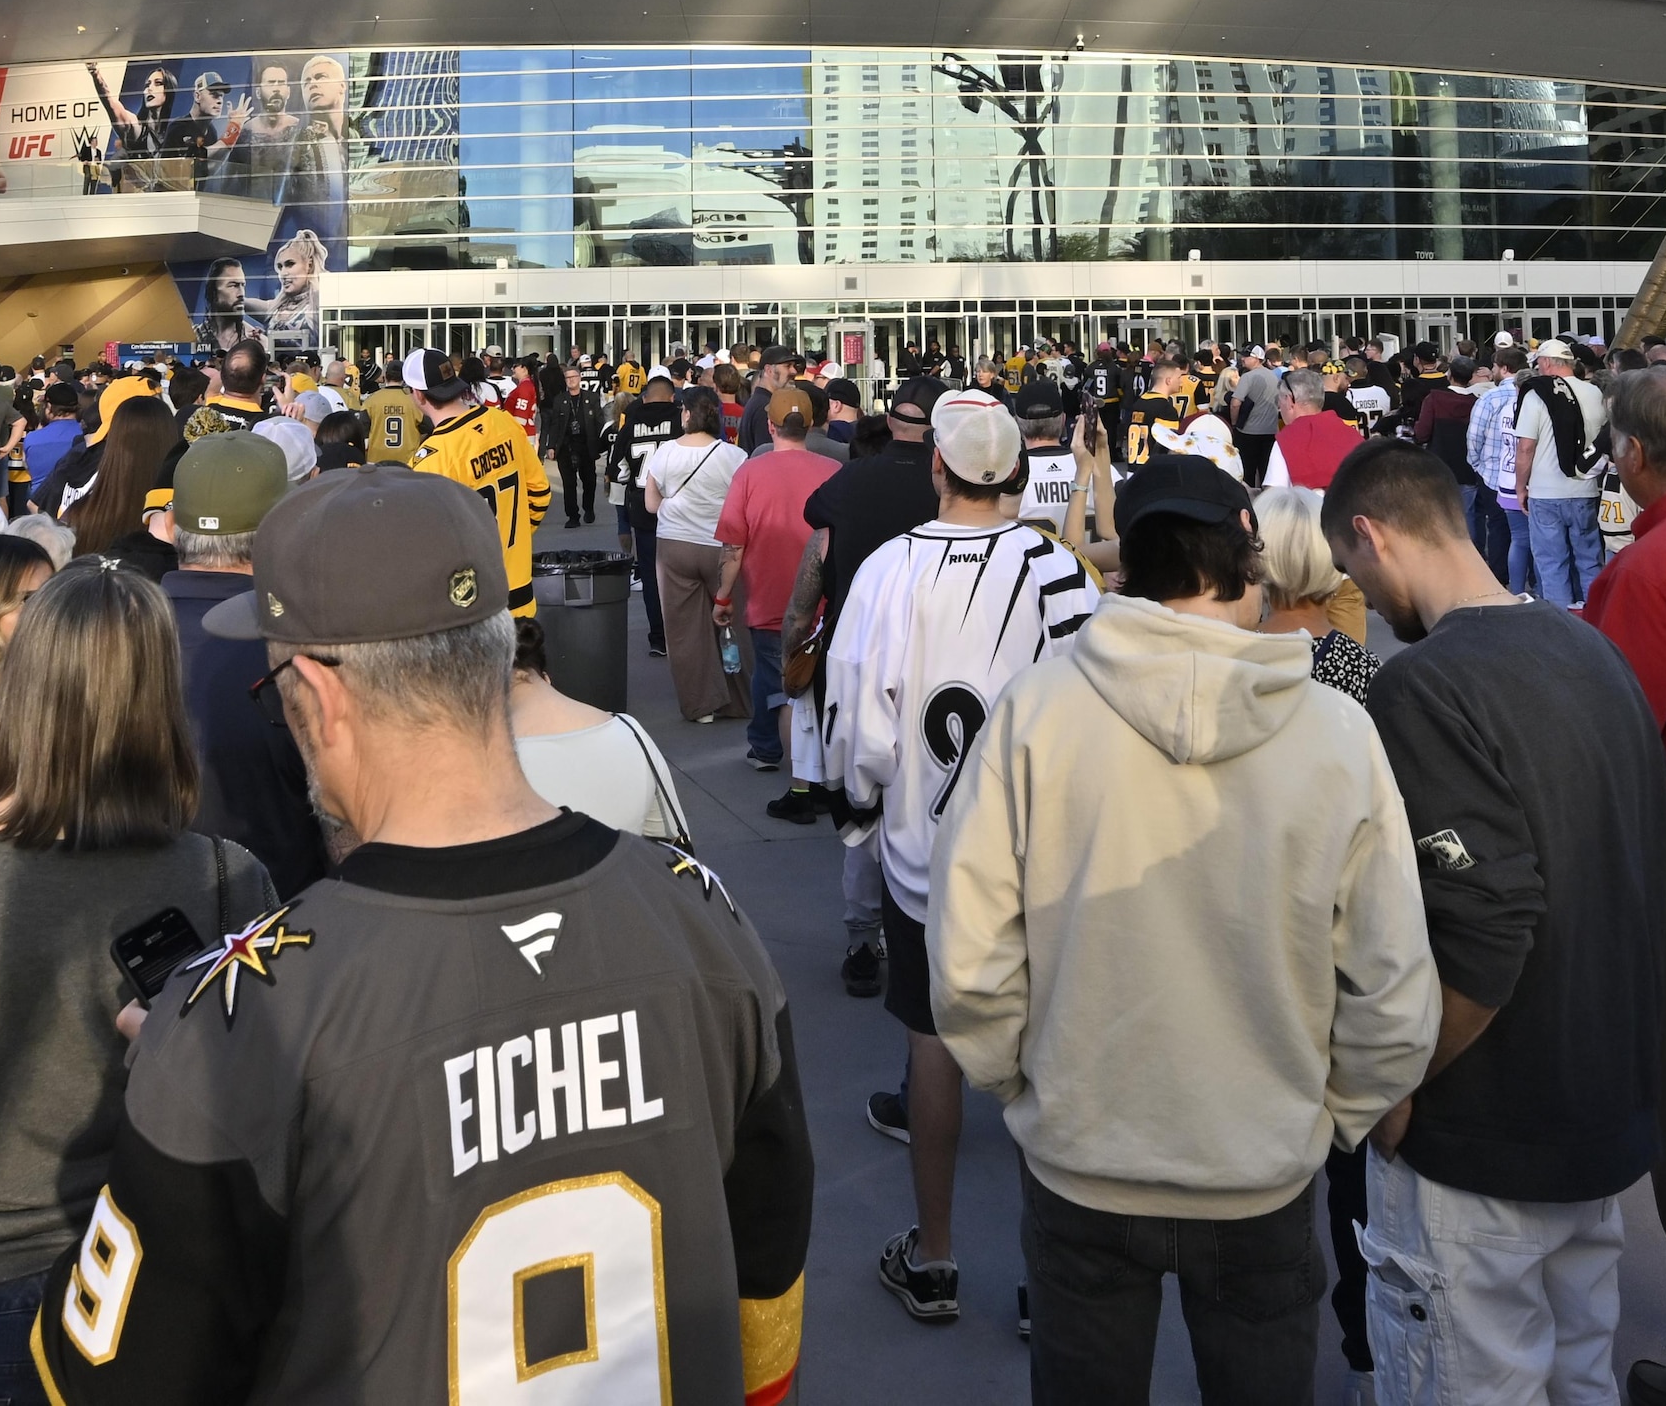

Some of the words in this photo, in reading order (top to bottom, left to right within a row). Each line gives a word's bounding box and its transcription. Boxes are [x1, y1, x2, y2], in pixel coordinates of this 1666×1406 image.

[11, 104, 67, 123] HOME
[73, 102, 99, 118] OF
[9, 134, 55, 159] UFC
[1415, 251, 1434, 259] TOYO
[196, 344, 211, 352] ATM
[628, 374, 640, 388] 87
[1096, 376, 1107, 395] 9
[383, 405, 406, 416] EICHEL
[515, 398, 528, 411] 35
[1356, 400, 1378, 409] CROSBY
[385, 416, 404, 448] 9
[1128, 424, 1150, 464] 87
[470, 439, 515, 480] CROSBY
[1600, 500, 1624, 523] 71
[948, 553, 987, 565] RIVAL
[443, 1010, 665, 1178] EICHEL
[61, 1184, 143, 1366] 9
